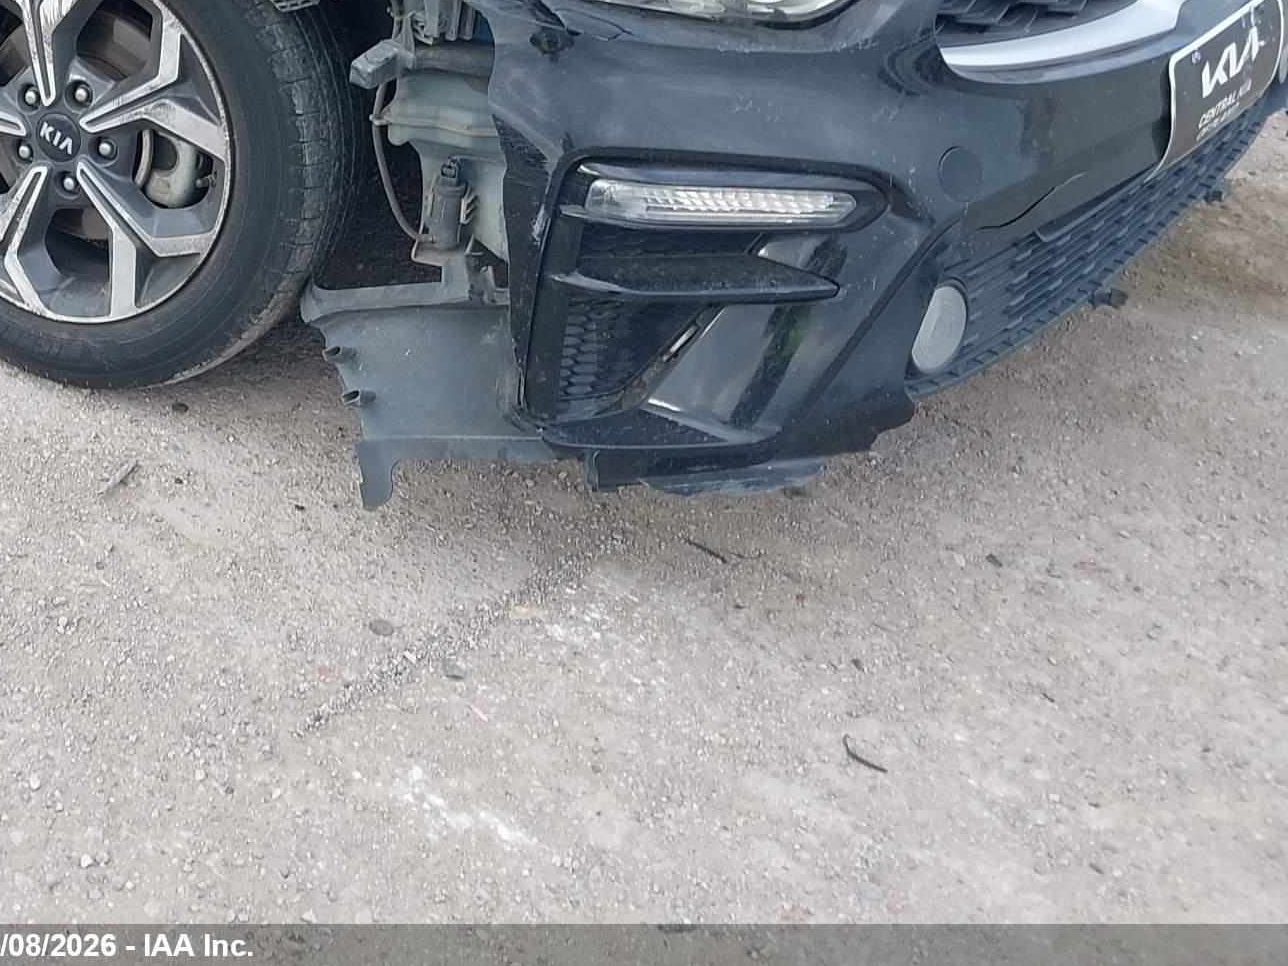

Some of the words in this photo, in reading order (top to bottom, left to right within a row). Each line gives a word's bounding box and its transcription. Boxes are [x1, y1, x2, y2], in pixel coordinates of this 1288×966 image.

[1201, 26, 1259, 99] KIA
[1198, 89, 1237, 129] CENTRAL
[39, 121, 73, 155] KIA
